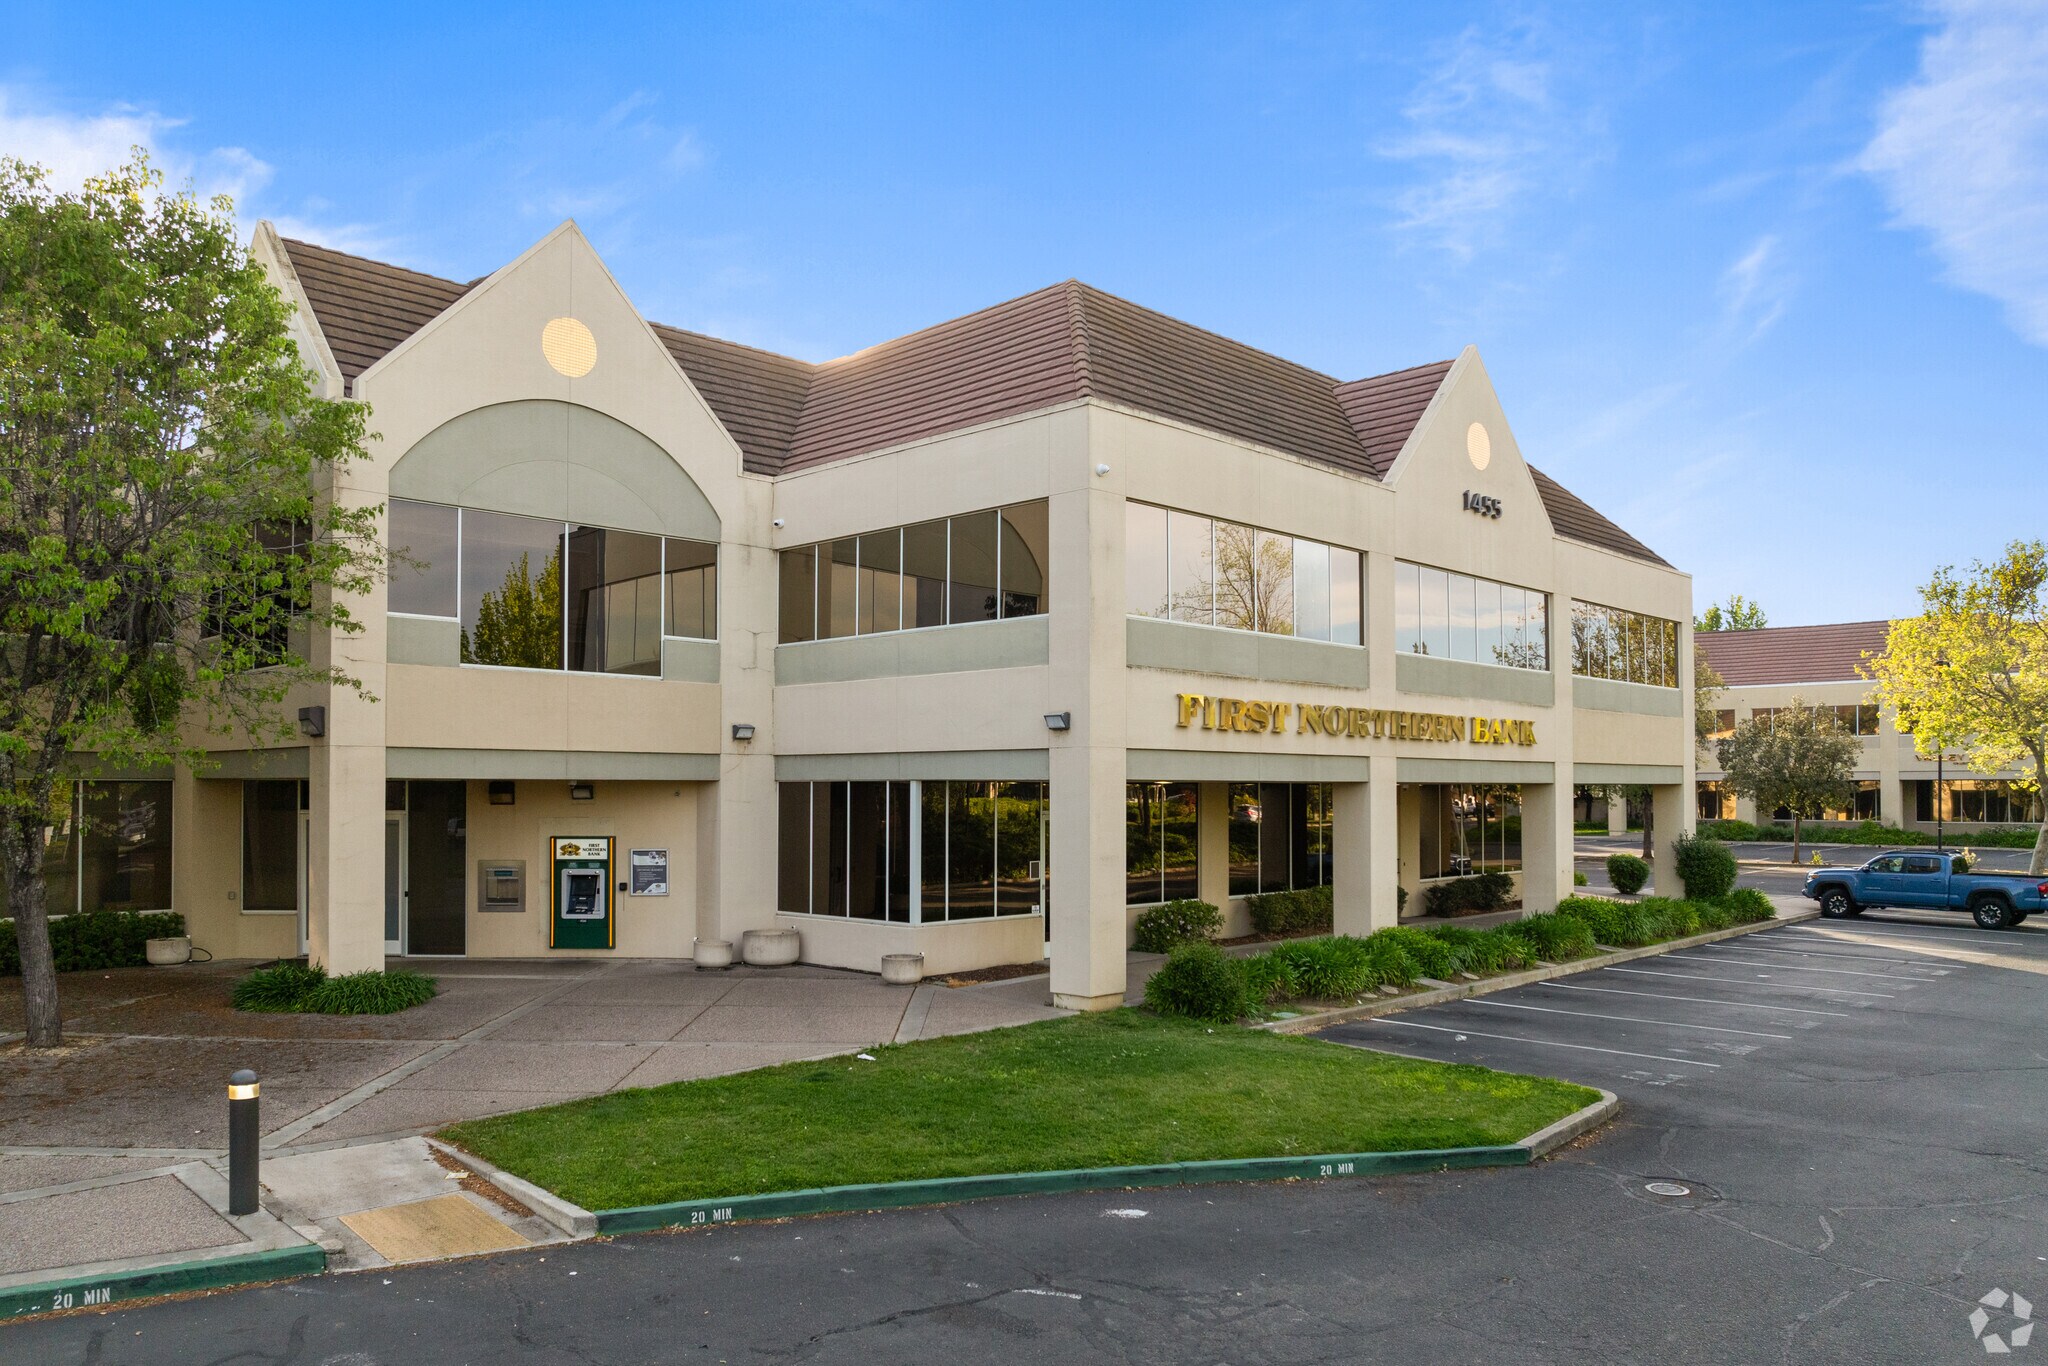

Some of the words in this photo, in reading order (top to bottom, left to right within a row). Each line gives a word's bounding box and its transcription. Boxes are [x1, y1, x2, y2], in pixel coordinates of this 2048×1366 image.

[1463, 490, 1502, 519] 1455
[1176, 693, 1291, 733] FIRST
[1297, 703, 1468, 742] NORTHERN
[1470, 716, 1538, 746] BANK
[1320, 1165, 1332, 1175] 20
[1337, 1162, 1354, 1174] MIN
[691, 1211, 705, 1223] 20
[713, 1207, 732, 1220] MIN
[53, 1293, 73, 1309] 20
[84, 1287, 111, 1305] MIN
